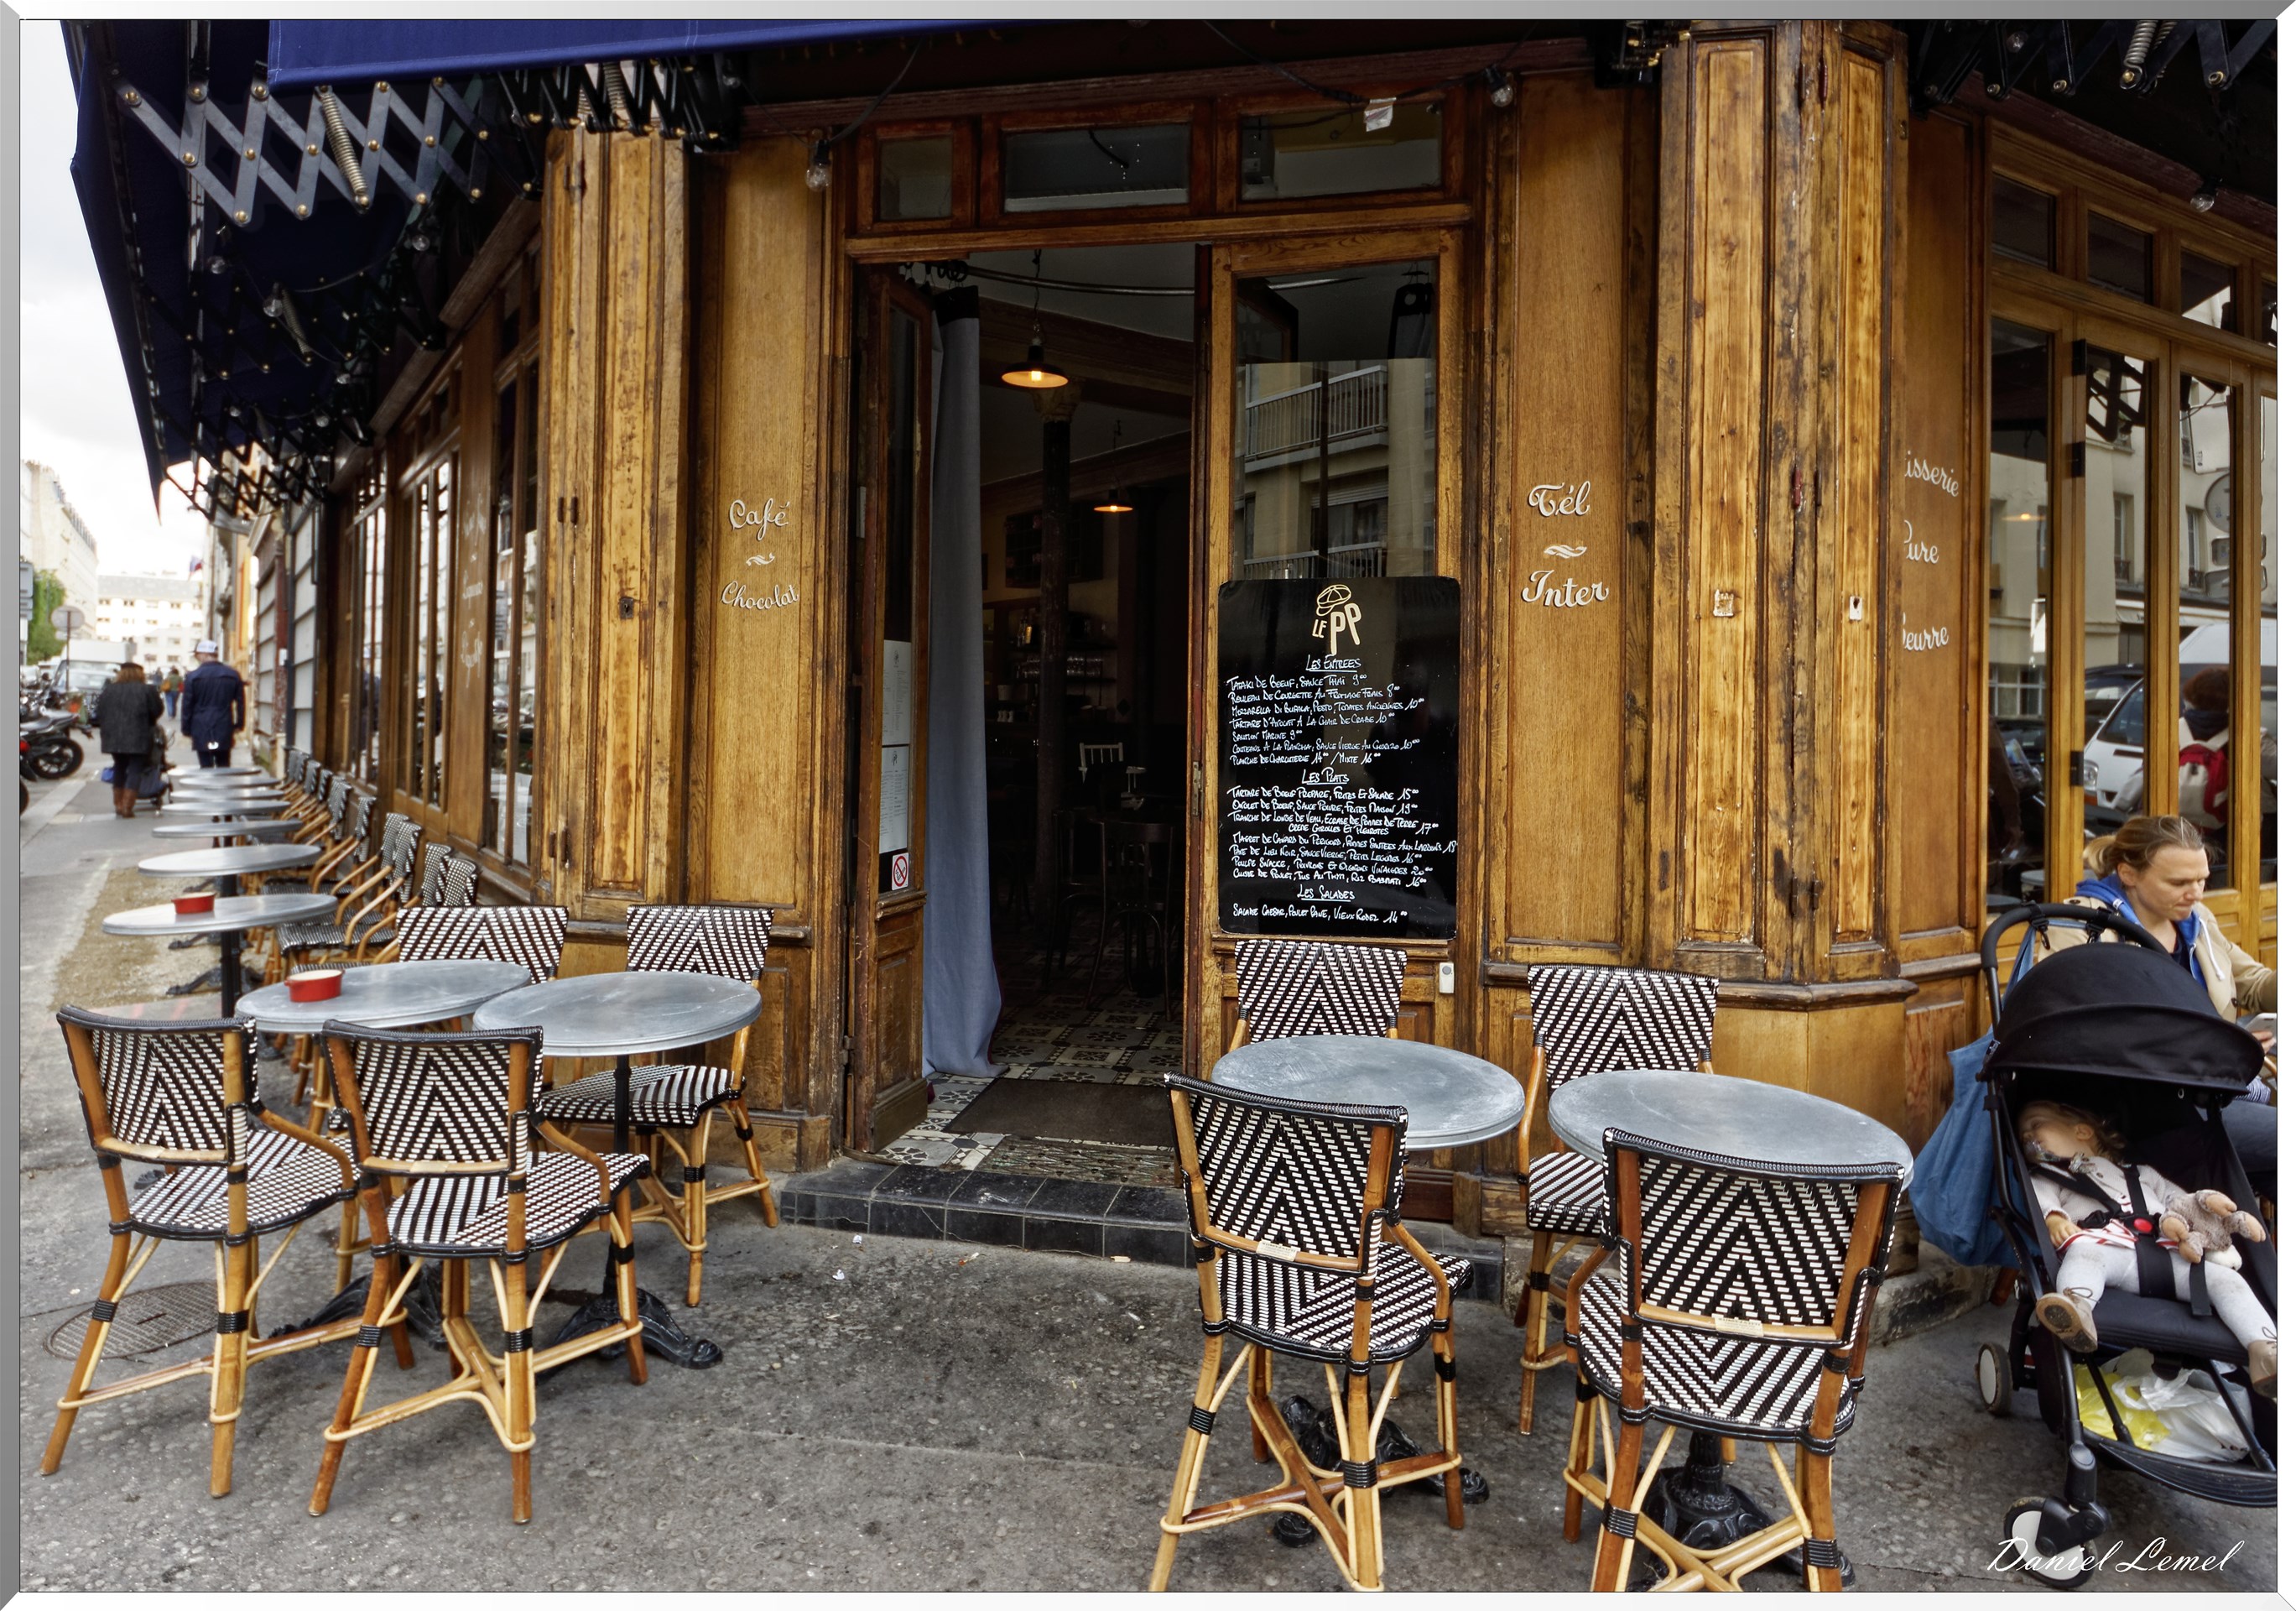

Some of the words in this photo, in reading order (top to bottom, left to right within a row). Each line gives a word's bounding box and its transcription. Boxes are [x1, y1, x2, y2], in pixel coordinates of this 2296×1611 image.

[1904, 451, 1959, 497] isserie
[1528, 481, 1591, 517] Tél
[729, 498, 790, 540] Café
[721, 581, 799, 609] Chocolat
[1522, 570, 1609, 607] Inter
[1312, 619, 1327, 638] LE
[1330, 602, 1361, 655] PP
